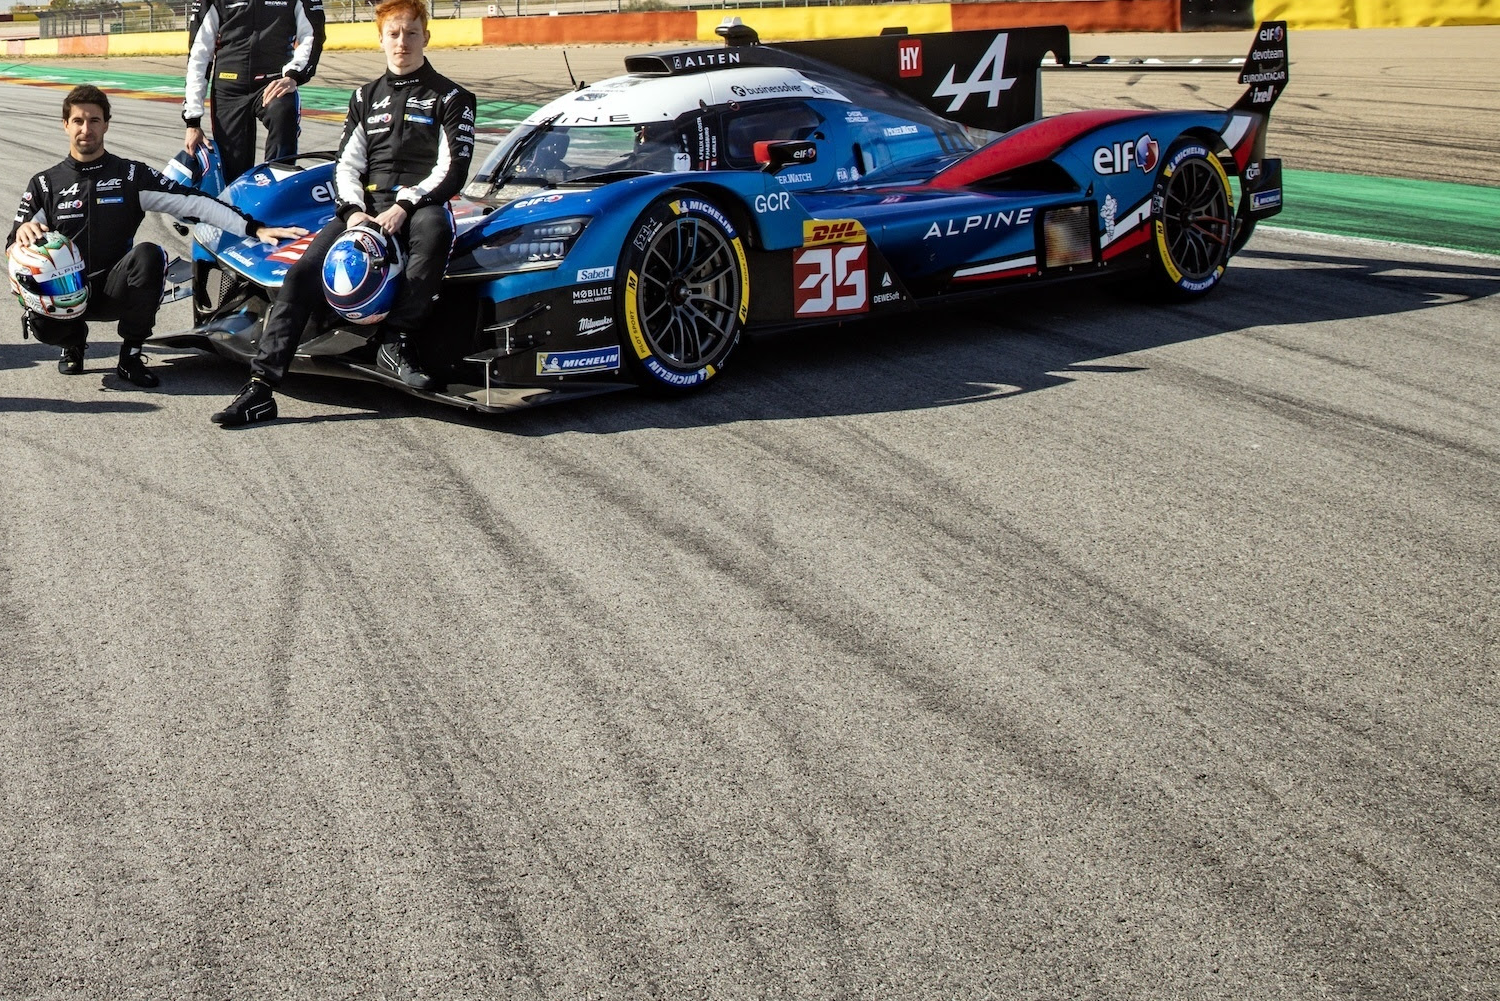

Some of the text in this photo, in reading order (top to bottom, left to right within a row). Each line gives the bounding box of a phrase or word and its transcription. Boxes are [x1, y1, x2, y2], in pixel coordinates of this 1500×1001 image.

[1260, 28, 1274, 41] elf
[685, 52, 741, 68] ALTEN
[900, 46, 919, 71] HY
[1252, 49, 1284, 61] devoteam
[1243, 71, 1286, 83] EURODATACAR
[746, 82, 803, 96] businessolver
[793, 149, 807, 159] elf
[1093, 140, 1136, 175] elf
[1174, 147, 1206, 164] MICHELIN
[311, 181, 337, 203] el
[57, 201, 73, 209] elf
[754, 191, 791, 214] GCR
[689, 200, 734, 234] MICHELIN
[923, 207, 1034, 241] ALPINE
[812, 221, 858, 242] DHL
[50, 263, 84, 278] ALPINE
[581, 268, 610, 280] Sabelt
[795, 245, 867, 314] 35
[1181, 275, 1214, 291] MICHELIN
[578, 316, 613, 331] Milwaukee
[562, 353, 618, 368] MICHELIN
[648, 359, 698, 384] MICHELIN
